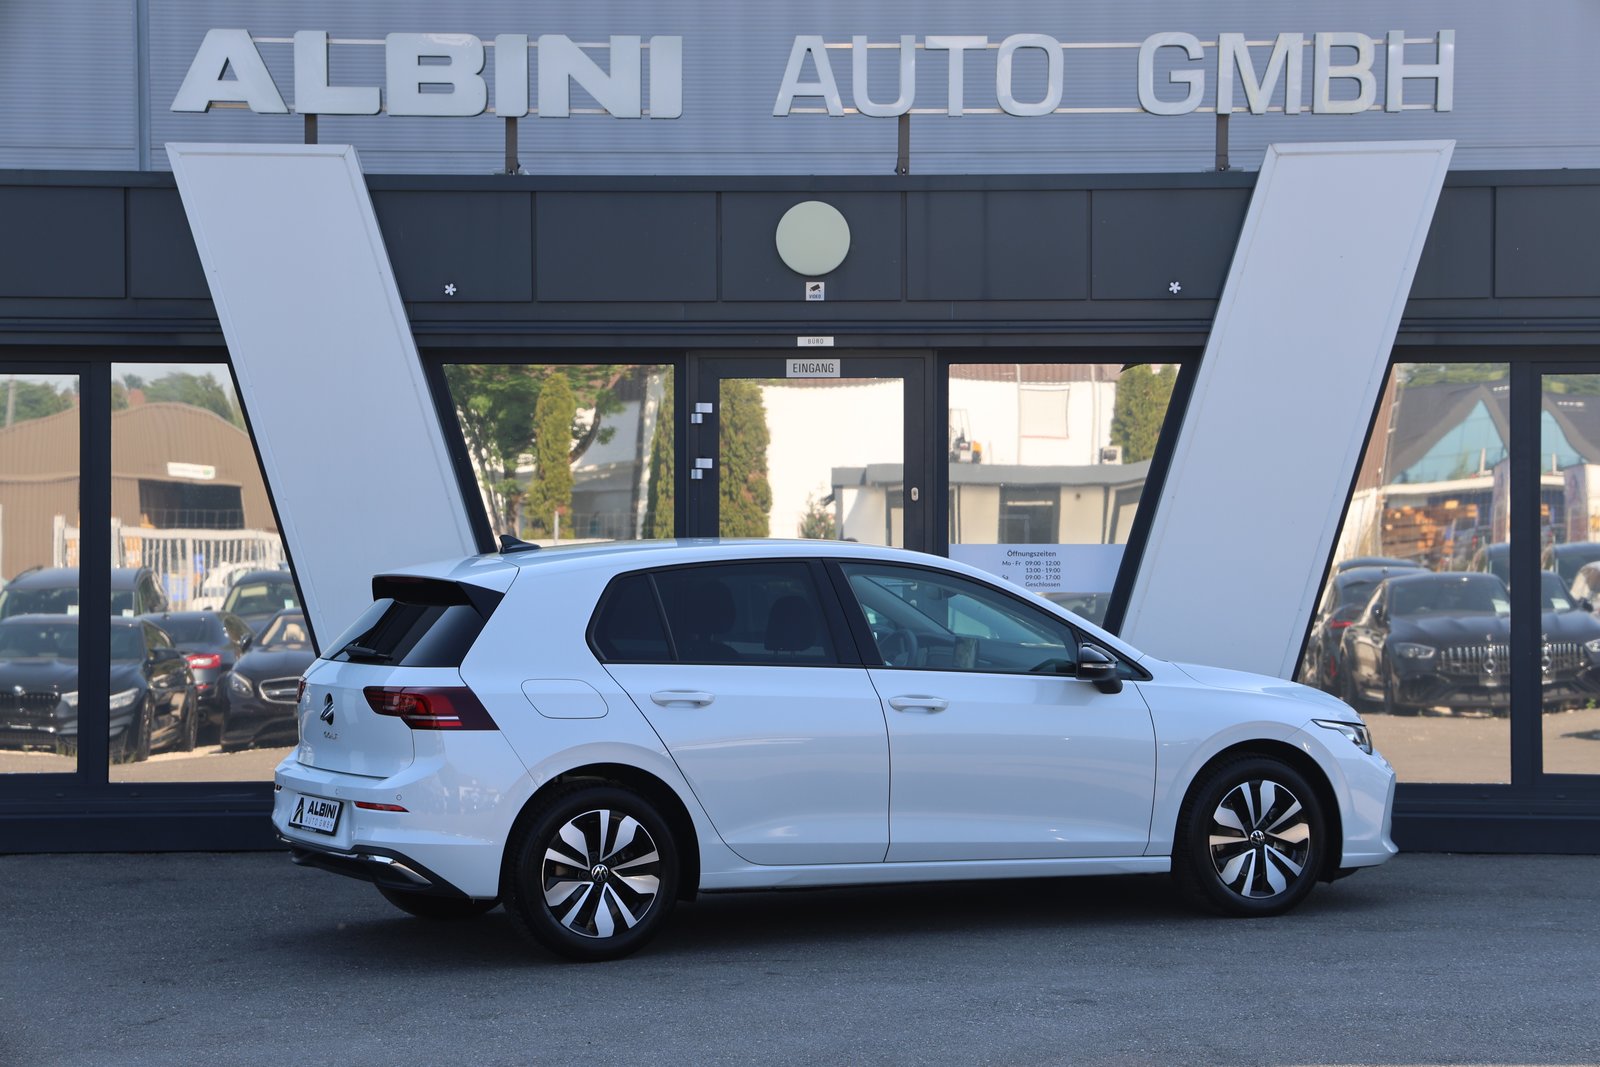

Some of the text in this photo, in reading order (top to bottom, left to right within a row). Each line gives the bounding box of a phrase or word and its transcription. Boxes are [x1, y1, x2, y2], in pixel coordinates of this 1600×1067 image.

[170, 28, 1456, 119] ALBINI AUTO GMBH
[793, 363, 834, 373] EINGANG
[307, 801, 338, 819] ALBINI
